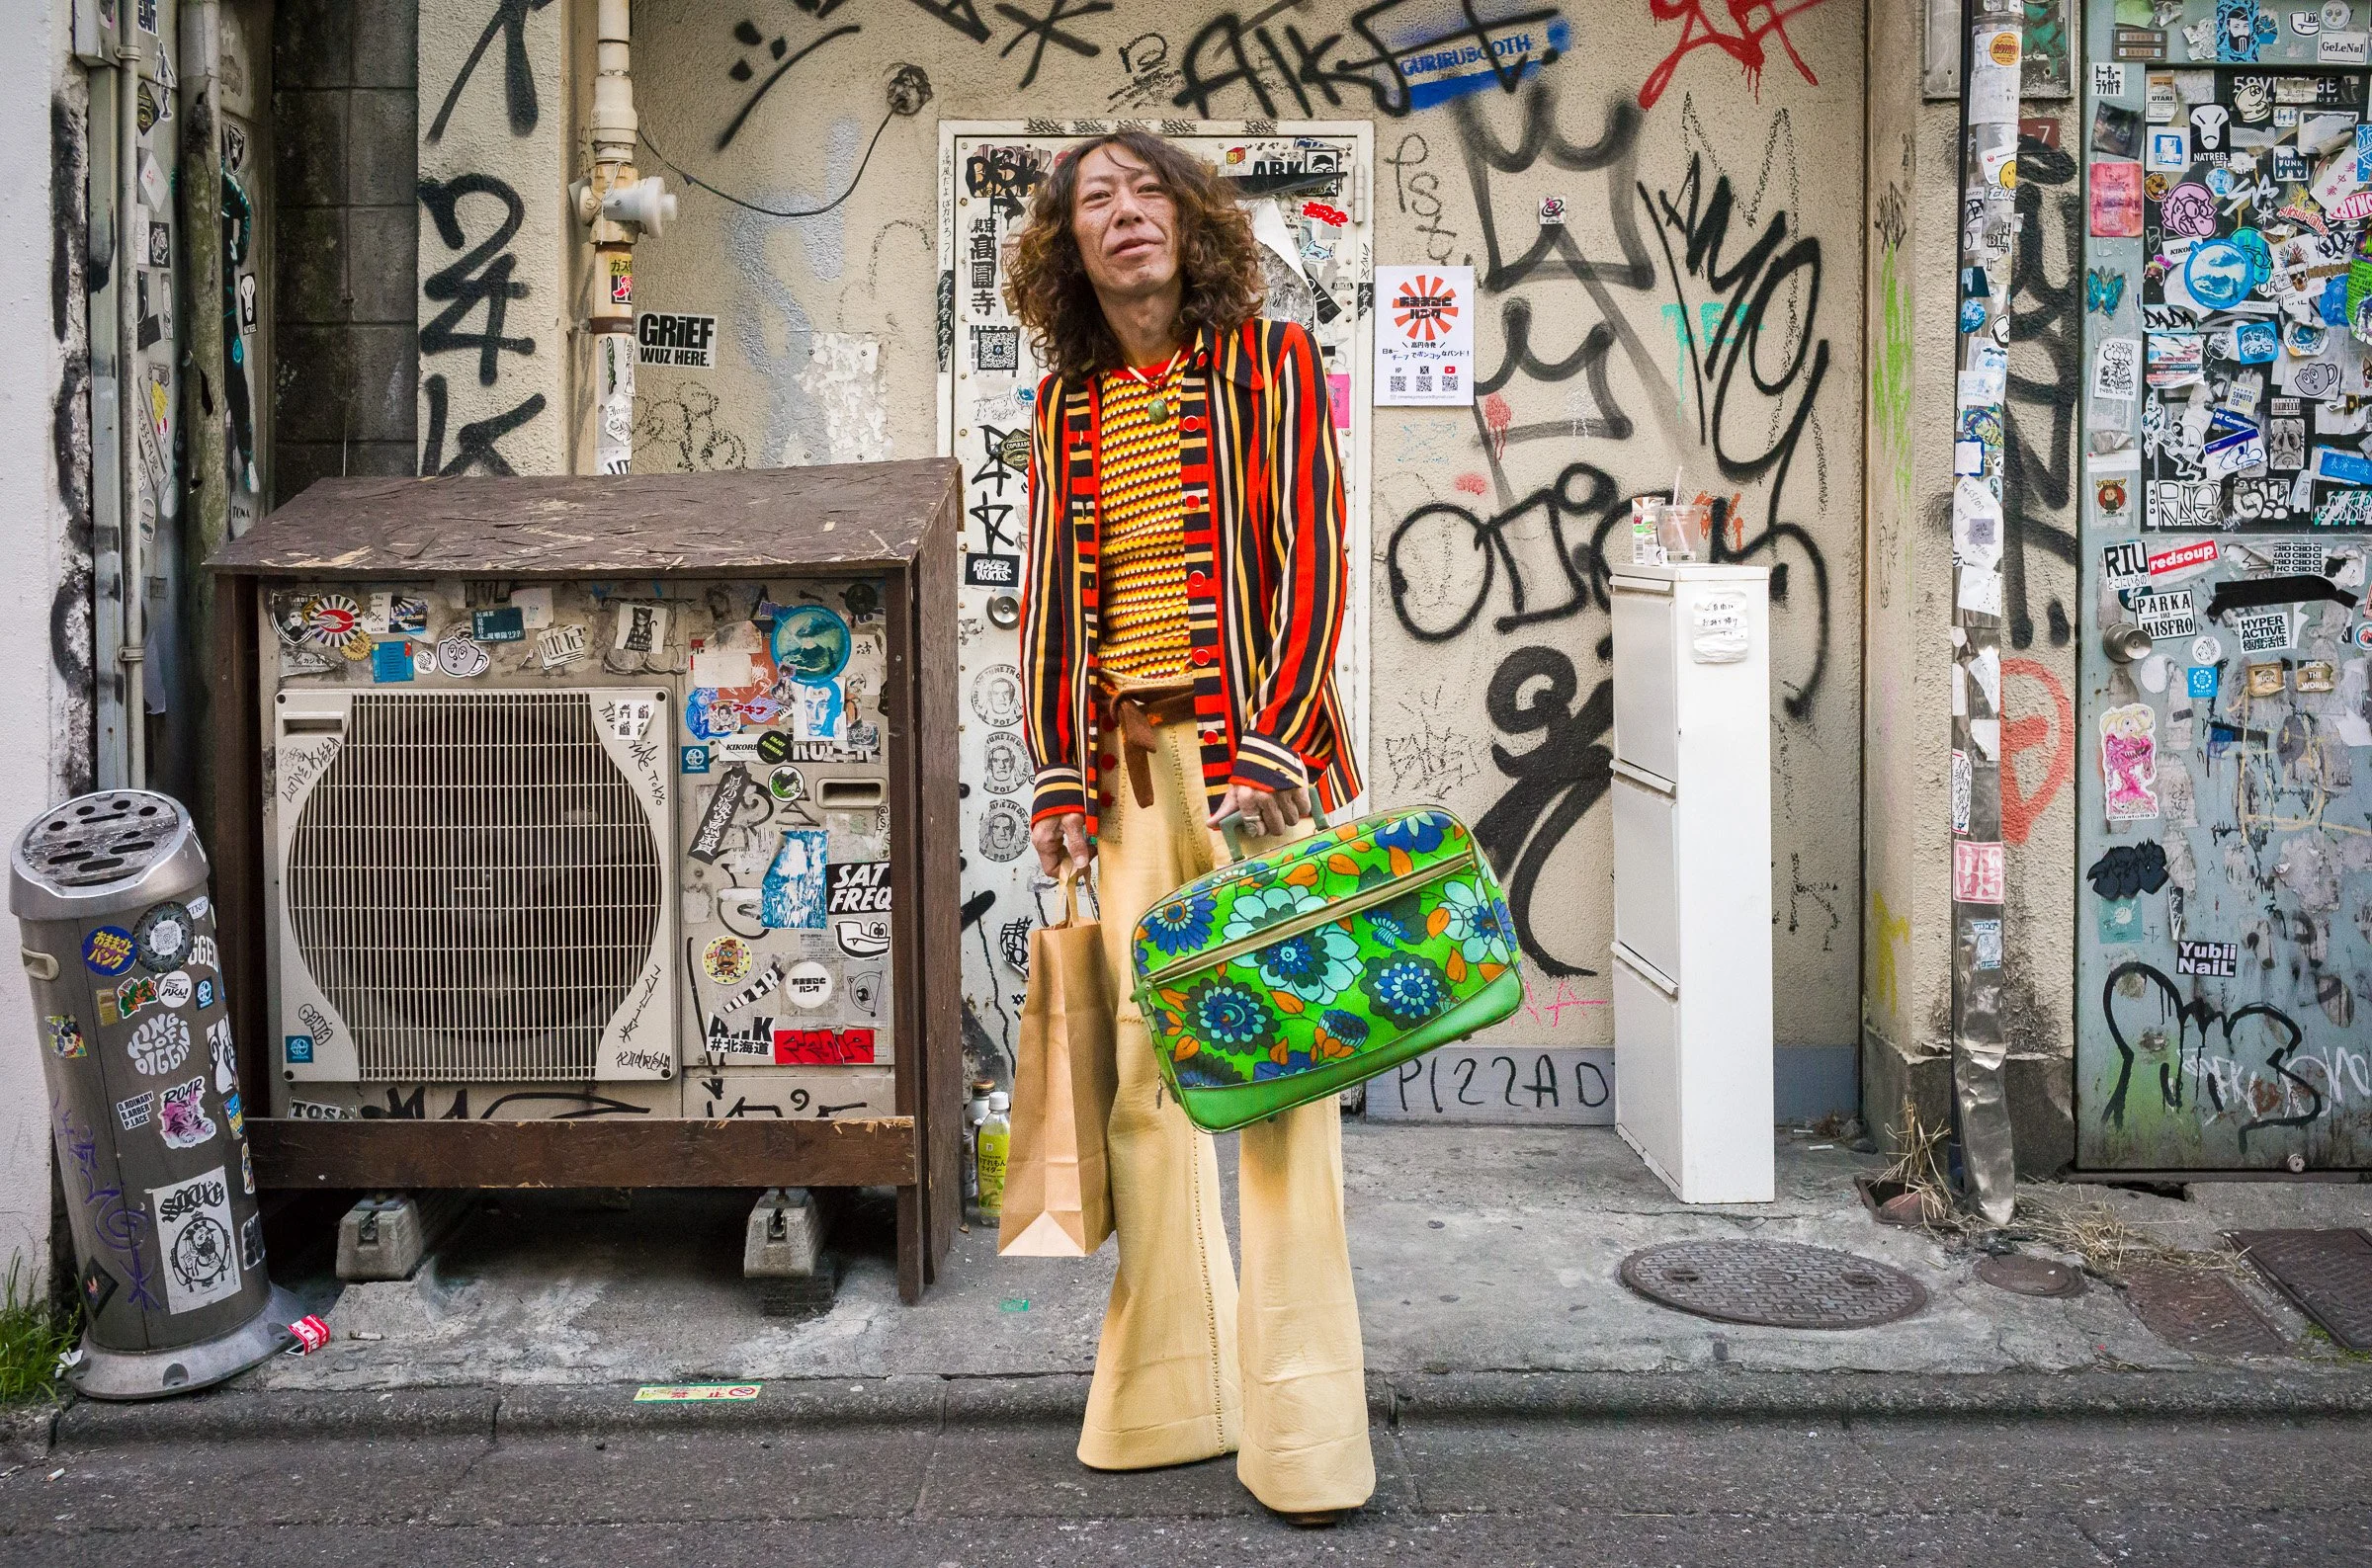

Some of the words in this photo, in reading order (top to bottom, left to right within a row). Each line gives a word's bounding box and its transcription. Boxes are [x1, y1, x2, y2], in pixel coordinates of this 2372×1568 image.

[2193, 152, 2229, 162] NATREEL
[638, 313, 715, 350] GRiEF
[640, 348, 671, 365] WUZ
[674, 349, 711, 367] HERE.
[2150, 544, 2215, 570] redsoup
[2137, 594, 2191, 614] PARKA
[2241, 615, 2284, 629] HYPER
[2242, 625, 2286, 639] ACTIVE
[993, 784, 1011, 793] POT
[831, 863, 890, 889] SAT
[828, 888, 892, 913] FREQ
[93, 931, 133, 956] おままごと
[2177, 942, 2237, 959] Yubii
[87, 948, 125, 970] パンク
[710, 1038, 770, 1055] #北海道
[163, 1076, 204, 1106] ROAR
